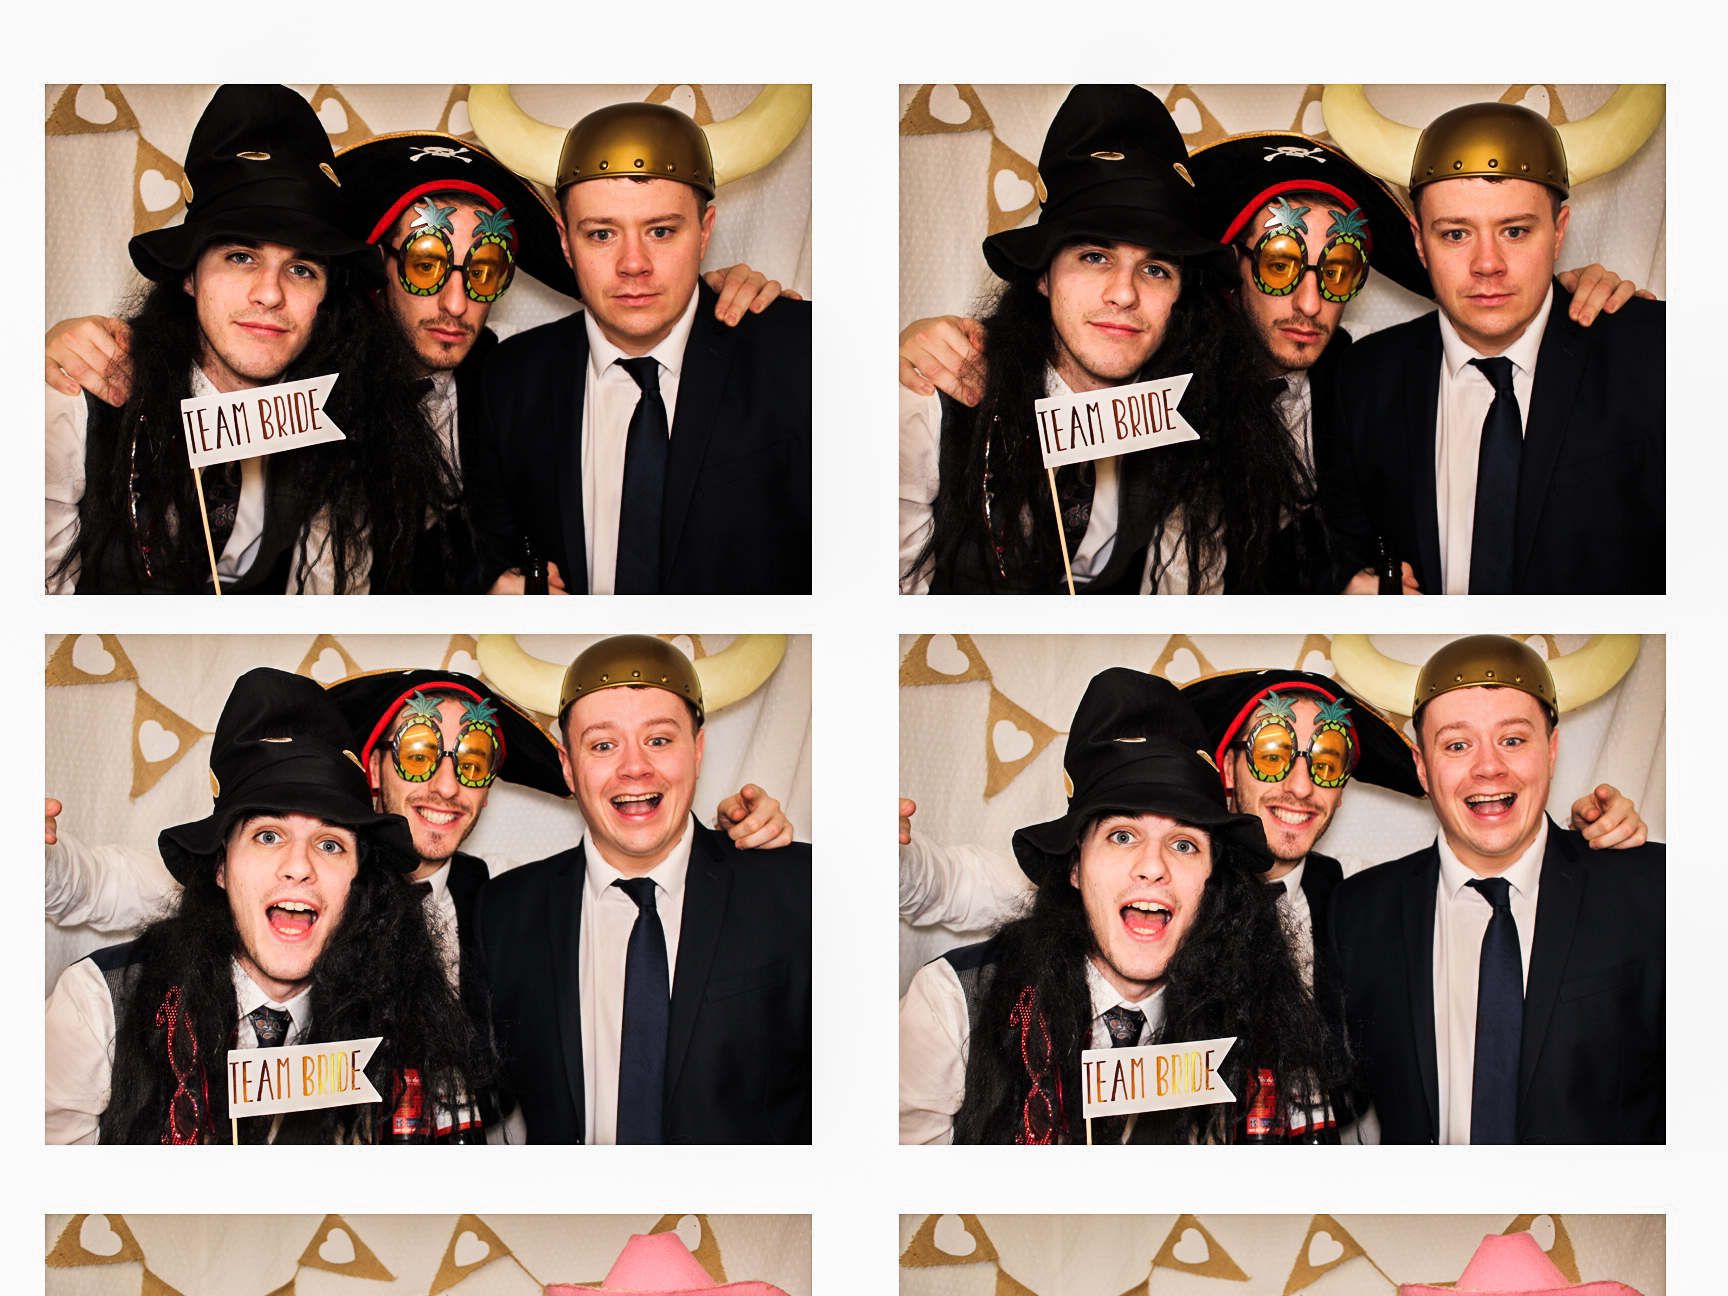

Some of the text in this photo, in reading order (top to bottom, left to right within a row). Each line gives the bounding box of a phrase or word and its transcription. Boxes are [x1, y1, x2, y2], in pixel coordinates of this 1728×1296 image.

[183, 389, 322, 454] TEAM BRIDE
[1037, 389, 1176, 454] TEAM BRIDE
[229, 1050, 361, 1104] TEAM BRIDE
[1083, 1050, 1215, 1104] TEAM BRIDE
